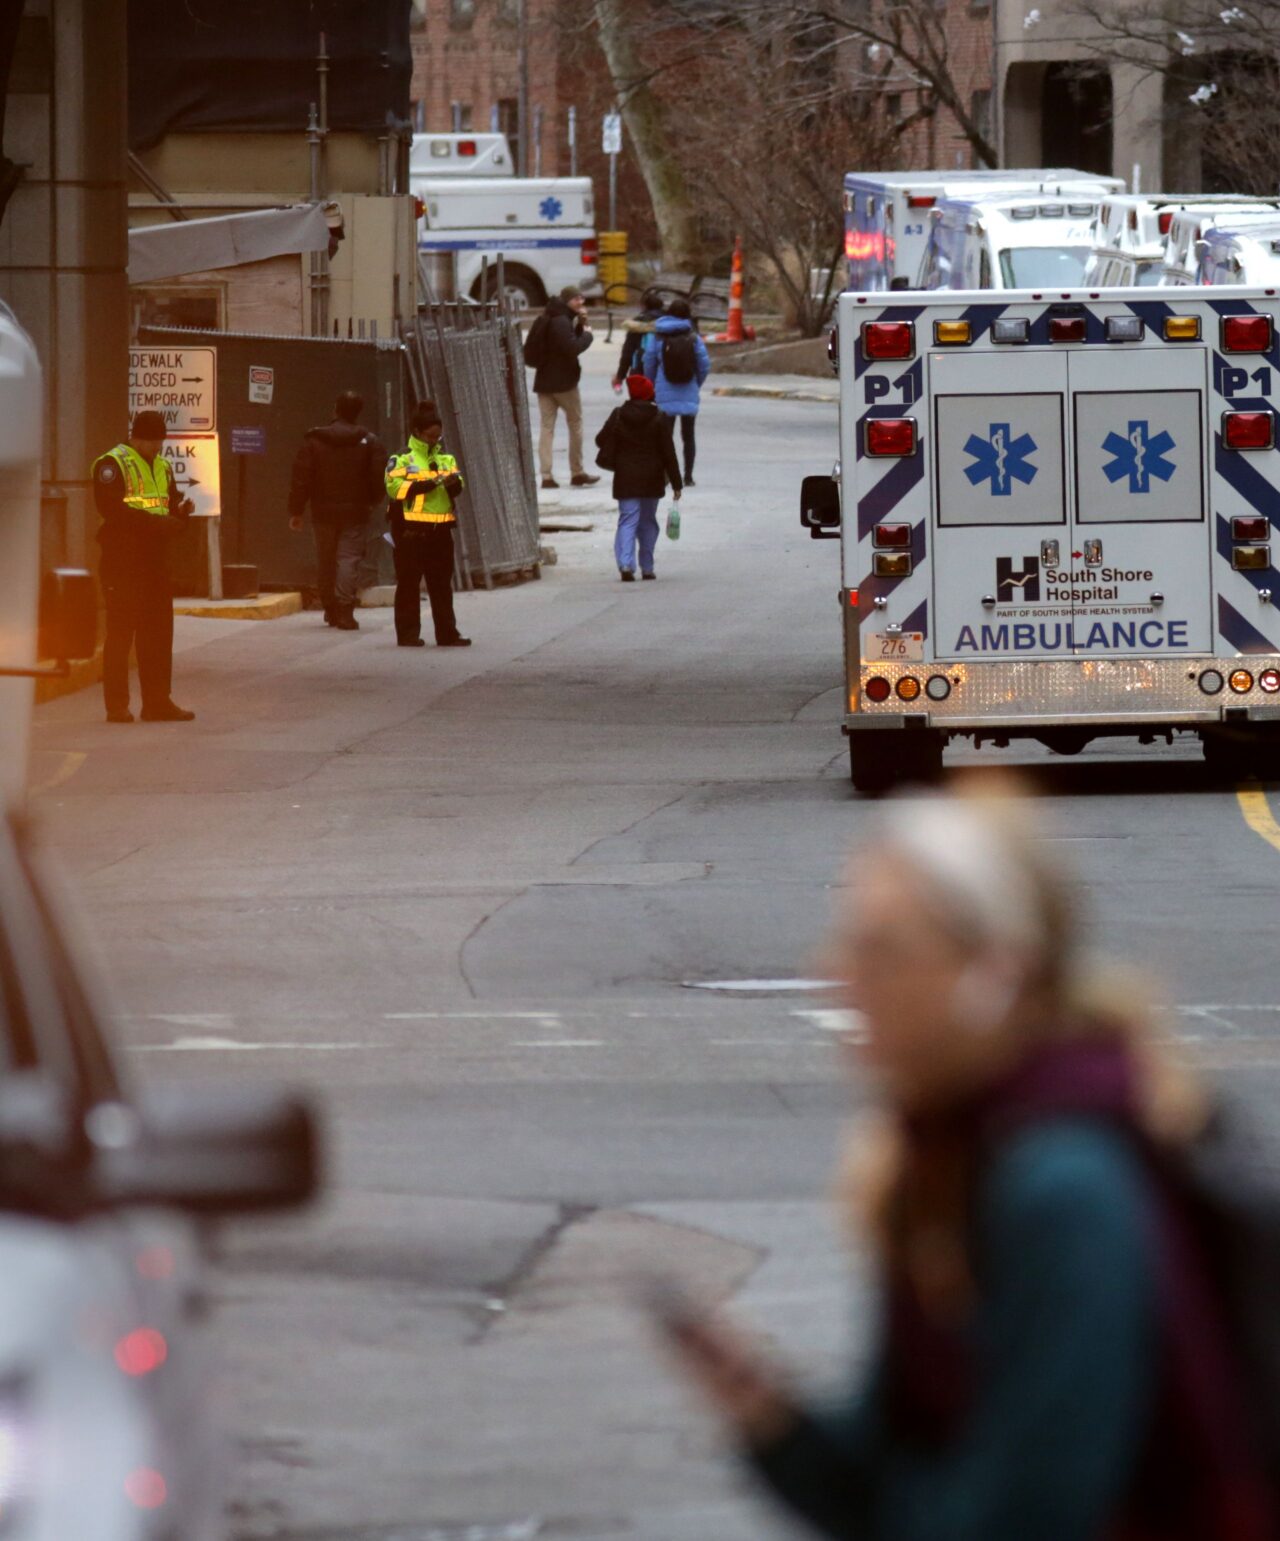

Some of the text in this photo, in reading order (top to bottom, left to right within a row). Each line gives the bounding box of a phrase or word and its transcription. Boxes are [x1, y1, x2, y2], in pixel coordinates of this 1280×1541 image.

[904, 225, 923, 235] A-3
[864, 374, 913, 404] P1
[1222, 367, 1271, 397] P1
[129, 393, 202, 406] TEMPORARY
[1046, 567, 1153, 584] South Shore
[1046, 586, 1118, 604] Hospital
[1019, 609, 1030, 617] OF
[1032, 609, 1059, 617] SOUTH
[1061, 608, 1087, 616] SHORE
[1090, 608, 1120, 616] HEALTH
[1122, 607, 1154, 615] SYSTEM
[954, 620, 1189, 651] AMBULANCE
[881, 640, 907, 655] 276
